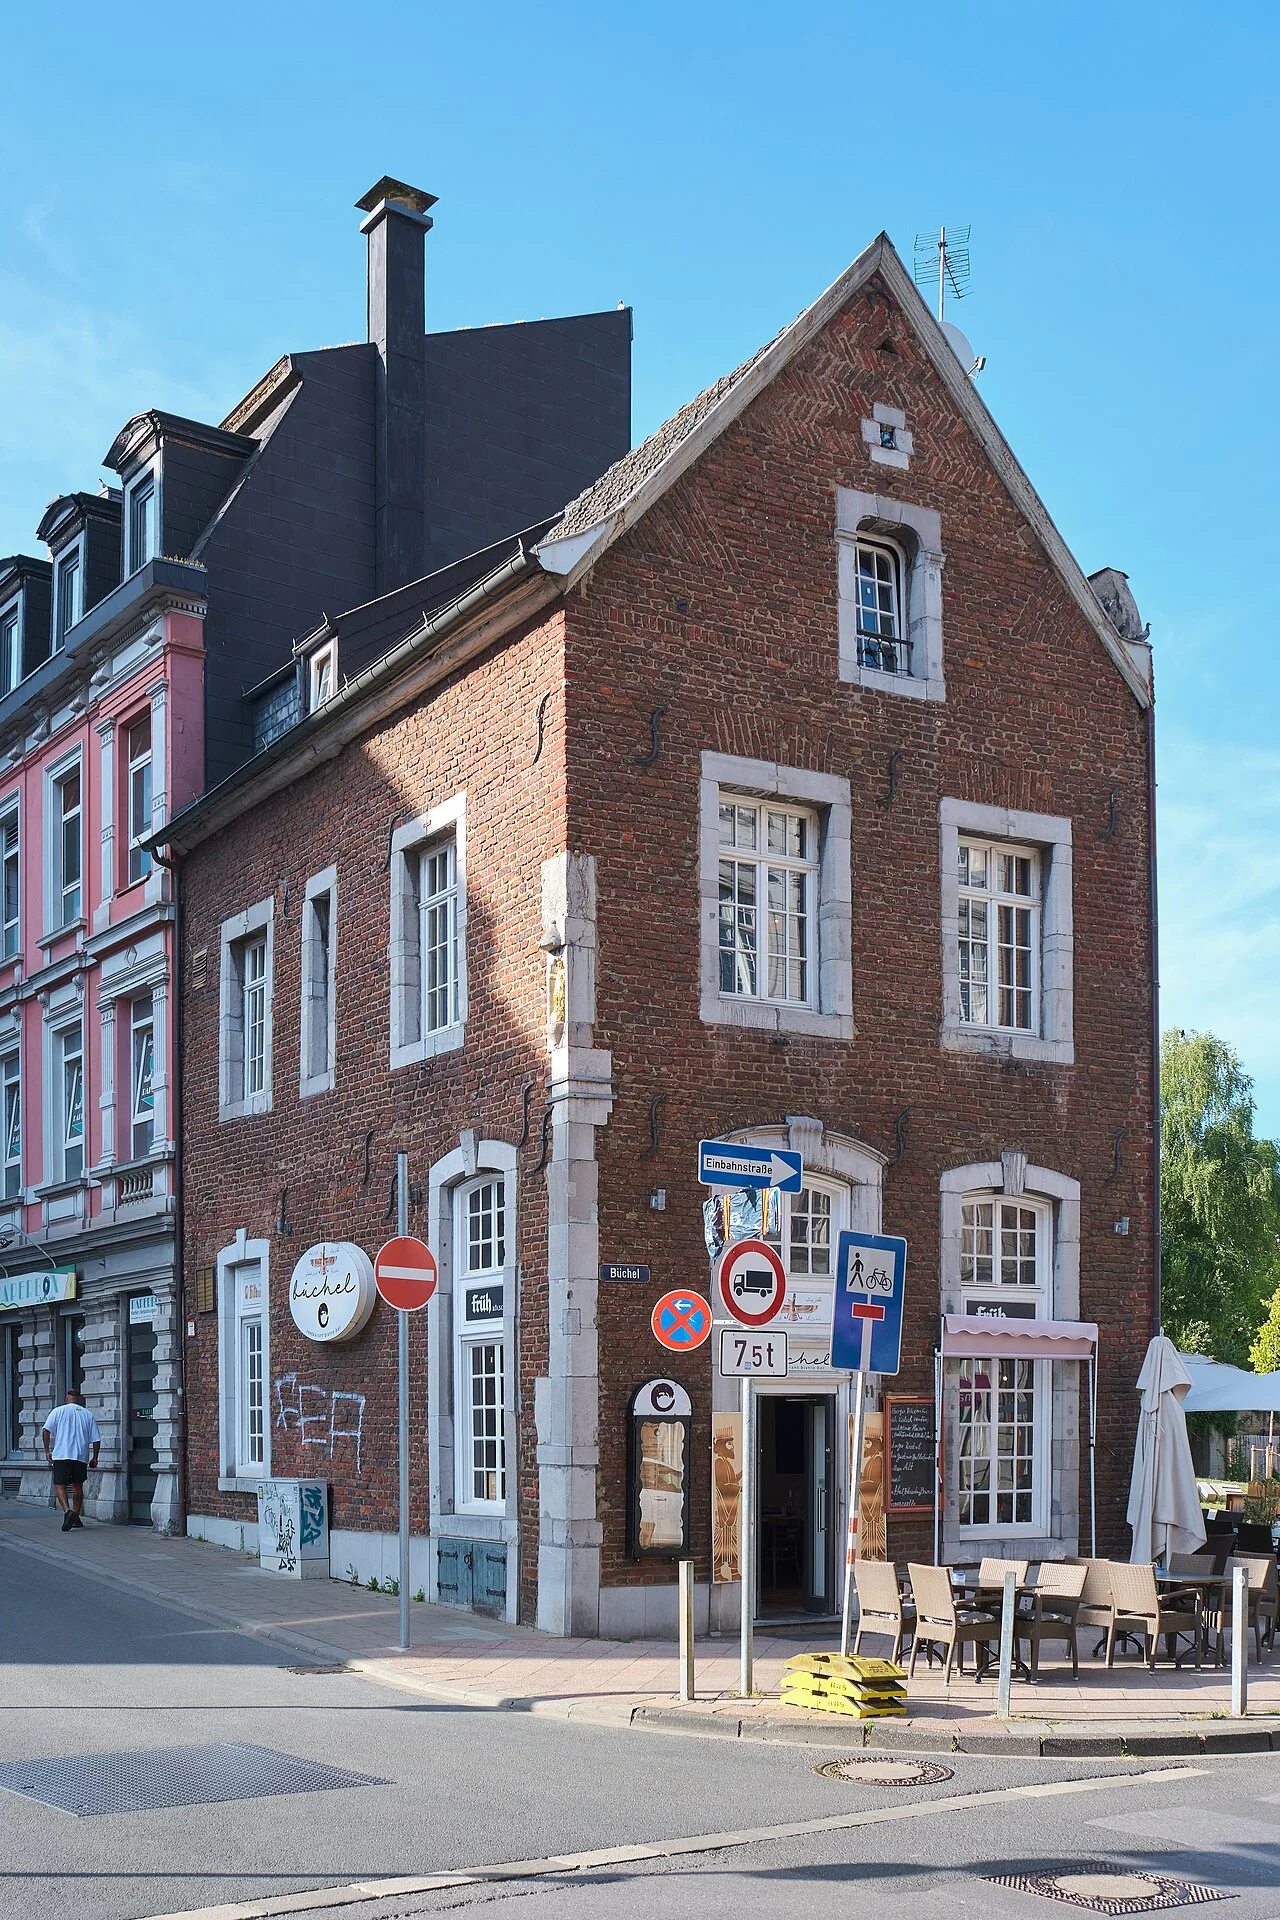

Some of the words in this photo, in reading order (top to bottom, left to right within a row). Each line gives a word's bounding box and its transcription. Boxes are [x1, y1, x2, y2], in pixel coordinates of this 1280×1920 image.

[706, 1157, 773, 1175] Einbahnstraße
[610, 1267, 640, 1279] Büchel
[0, 1274, 59, 1303] APERBOX
